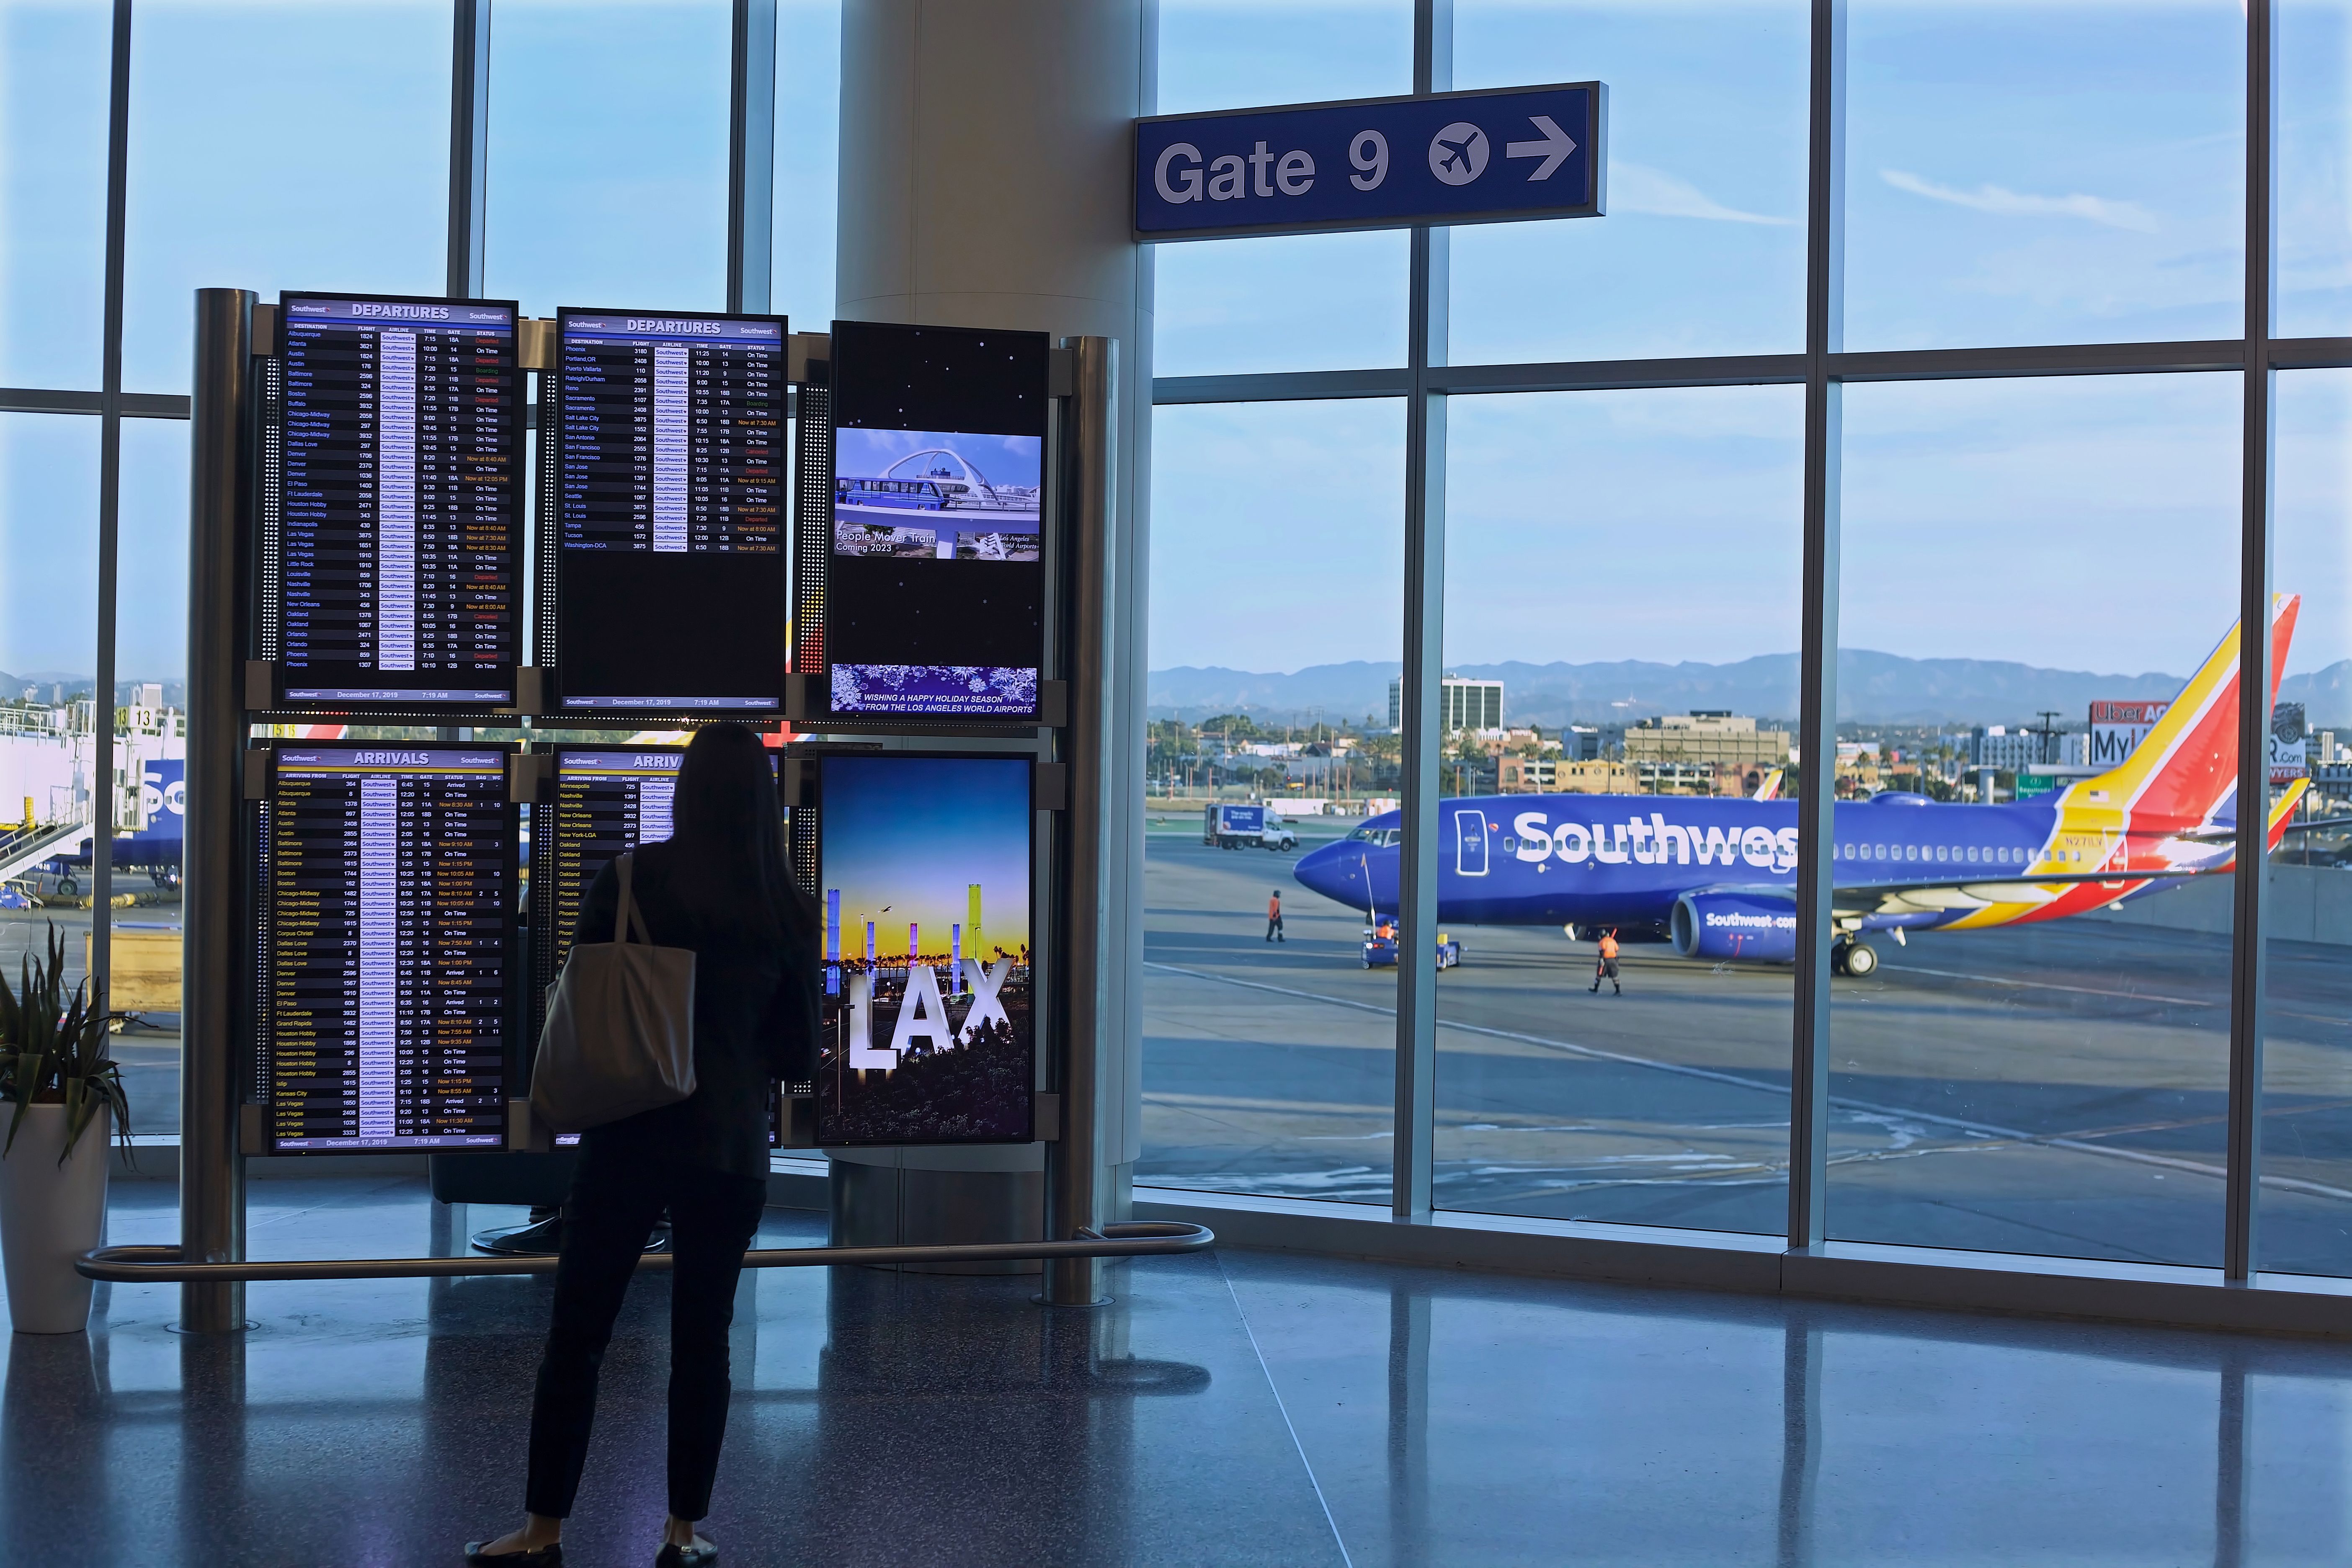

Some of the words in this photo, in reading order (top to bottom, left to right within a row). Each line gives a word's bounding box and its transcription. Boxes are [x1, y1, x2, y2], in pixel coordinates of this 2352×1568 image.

[1155, 140, 1315, 204] Gate
[1349, 130, 1388, 191] 9
[352, 304, 449, 319] DEPARTURES
[627, 320, 721, 334] DEPARTURES
[837, 531, 871, 541] People
[874, 531, 906, 542] Mover
[912, 533, 936, 544] Train
[836, 543, 868, 552] Coming
[871, 544, 891, 552] 2023
[119, 709, 126, 725] 13
[137, 710, 150, 725] 13
[2095, 703, 2142, 721] Uber
[354, 752, 429, 765] ARRIVALS
[634, 756, 682, 768] ARRIV
[2270, 767, 2303, 778] WYERS
[1514, 812, 1798, 868] Southwes
[849, 958, 1015, 1069] LAX
